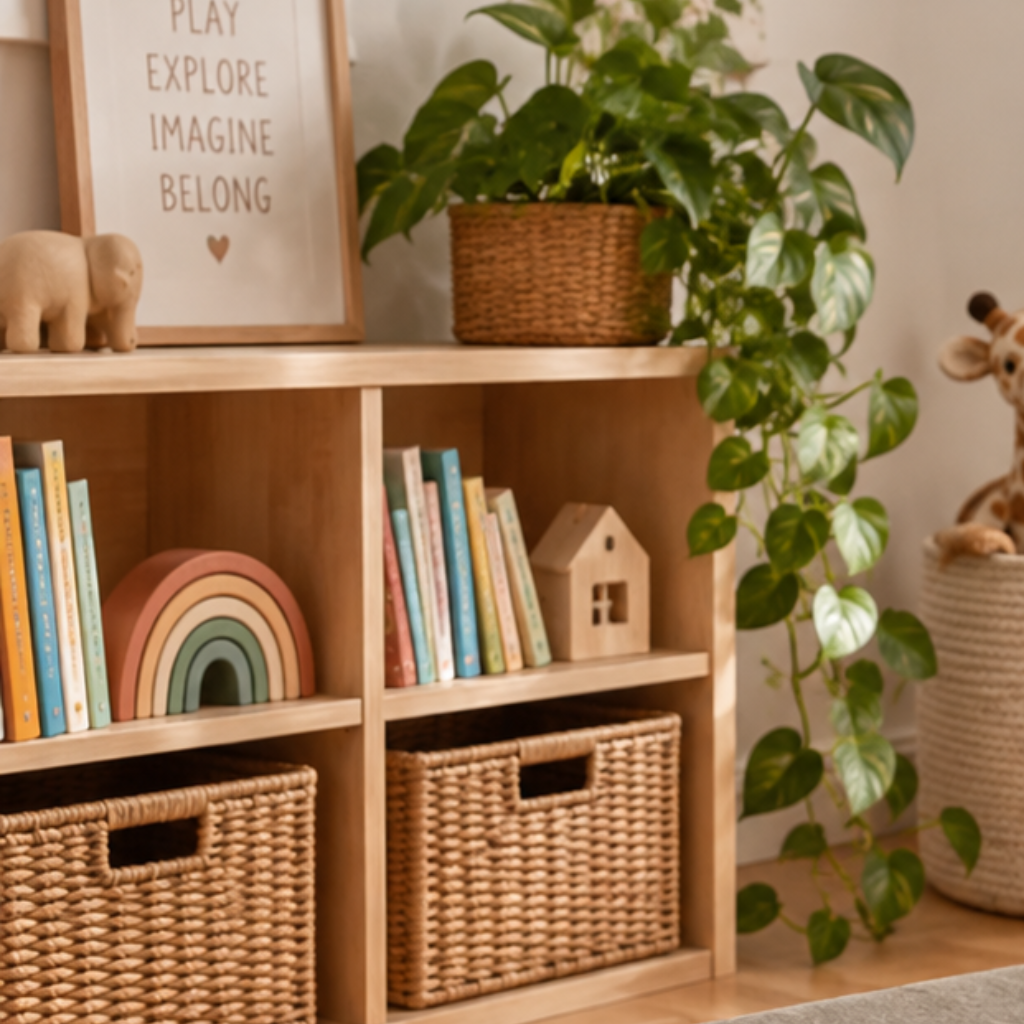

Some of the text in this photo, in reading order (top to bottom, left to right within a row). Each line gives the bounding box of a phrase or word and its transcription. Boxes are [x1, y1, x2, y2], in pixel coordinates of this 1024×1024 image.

[170, 0, 239, 36] PLAY
[146, 53, 269, 97] EXPLORE
[150, 113, 274, 156] IMAGINE
[160, 173, 272, 214] BELONG
